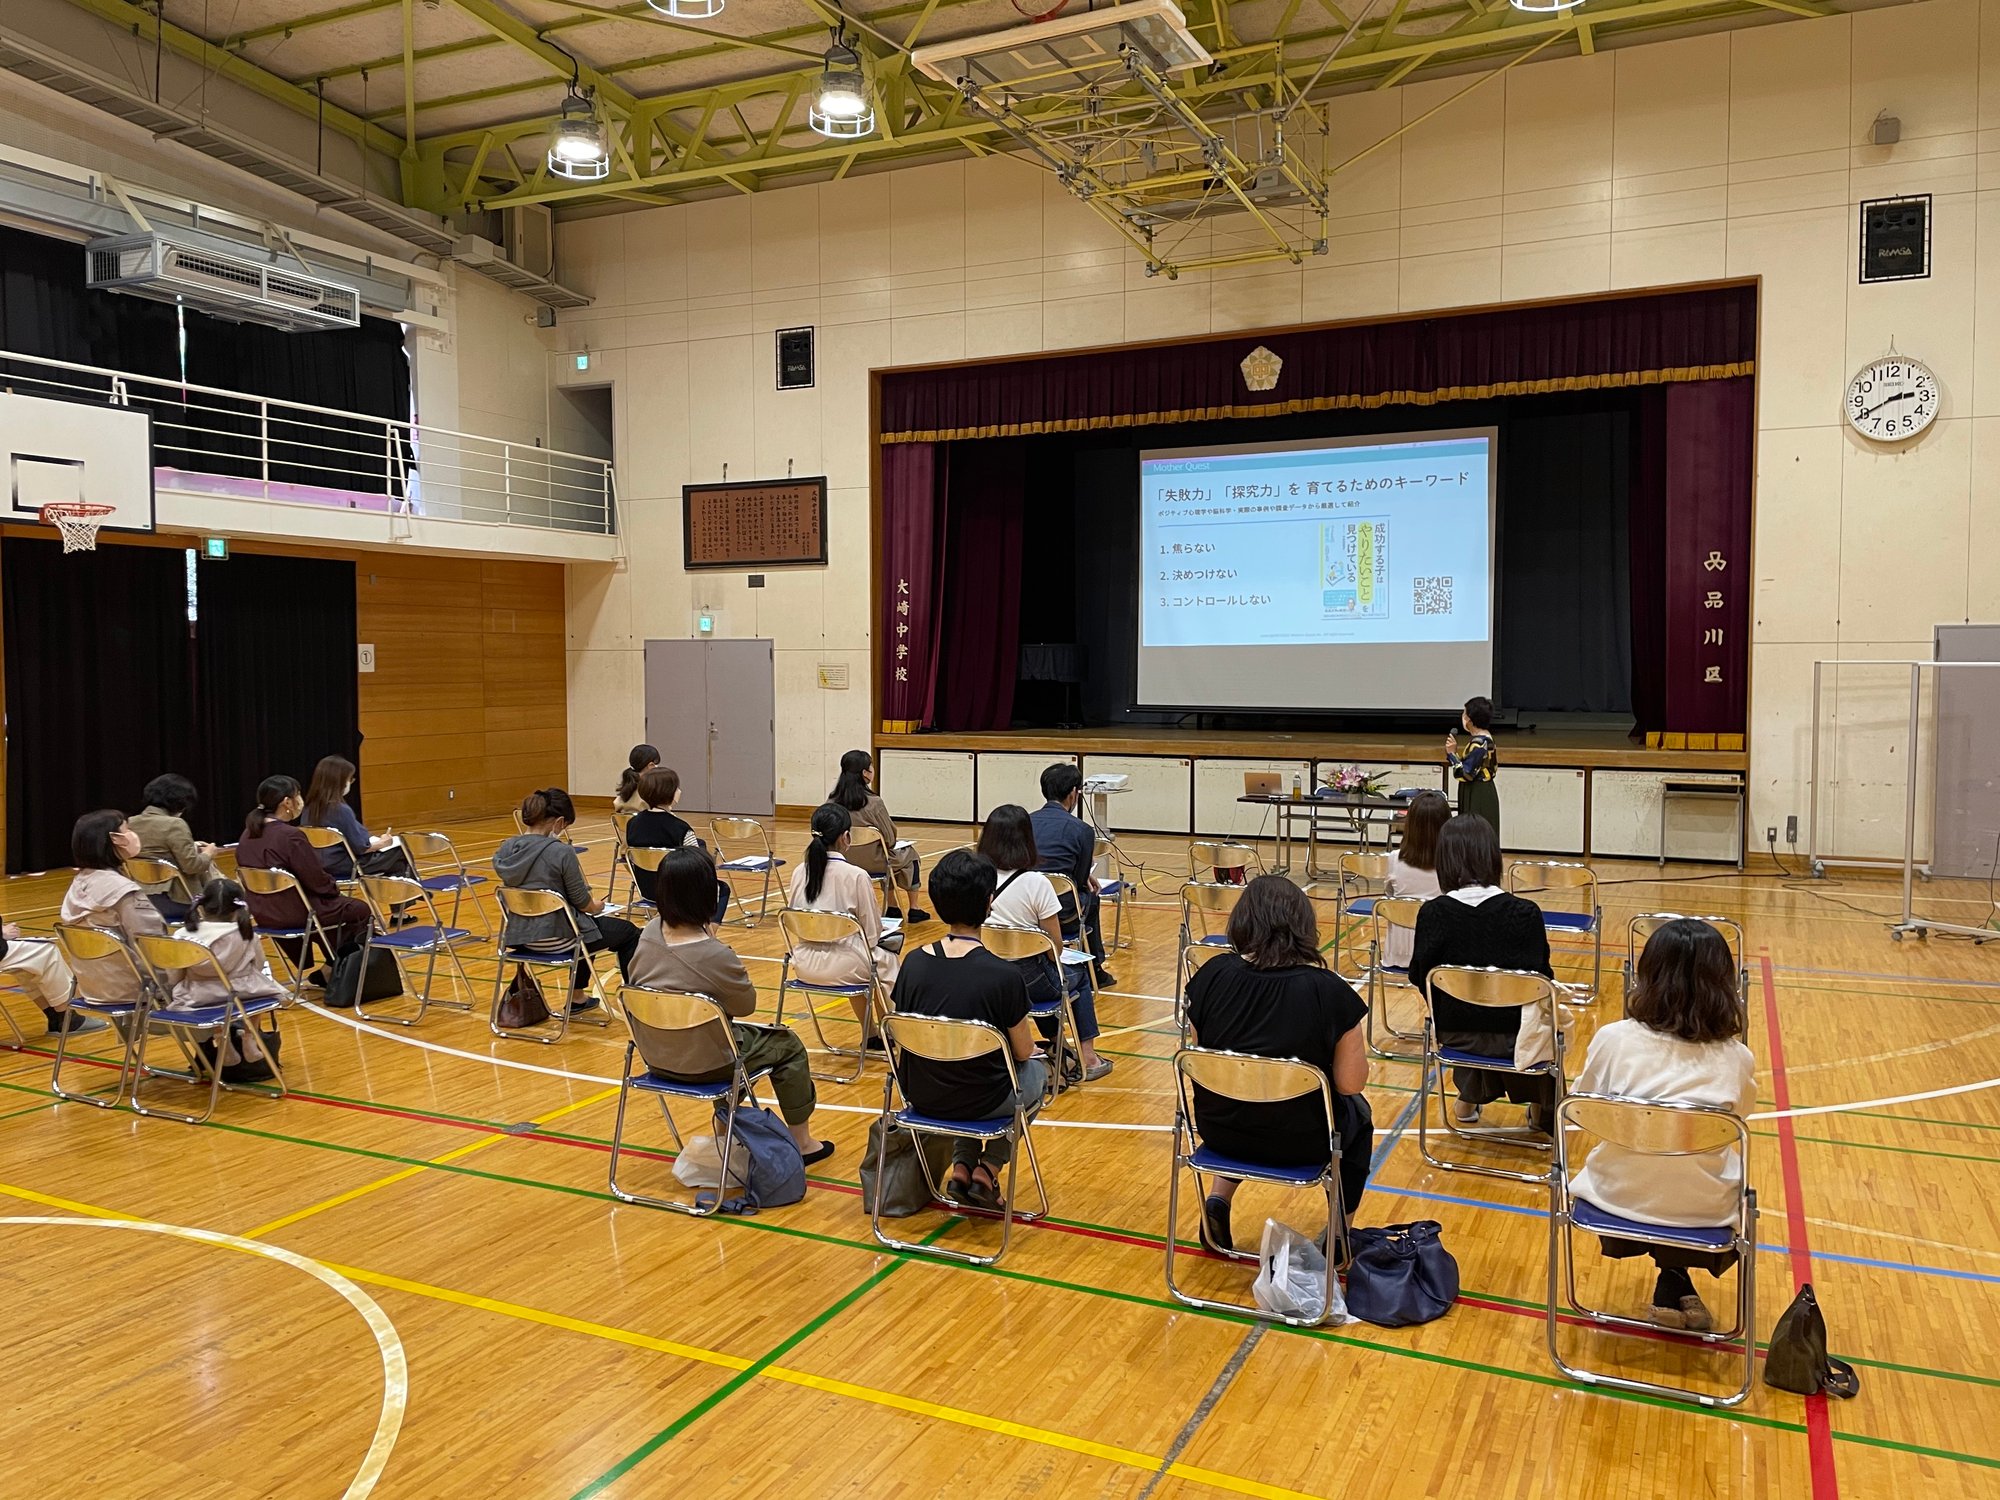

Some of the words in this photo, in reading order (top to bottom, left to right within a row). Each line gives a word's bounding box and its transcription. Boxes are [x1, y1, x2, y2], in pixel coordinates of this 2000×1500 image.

[1873, 370, 1882, 381] 11
[1887, 366, 1900, 377] 12
[1859, 381, 1872, 393] 10
[1916, 376, 1926, 388] 2
[1854, 395, 1864, 407] 9
[1920, 390, 1930, 402] 3
[1914, 404, 1923, 415] 4
[1872, 418, 1881, 429] 7
[1886, 420, 1896, 432] 6
[1903, 415, 1912, 427] 5
[1153, 463, 1183, 472] Mother
[1186, 462, 1210, 472] Quest
[1307, 472, 1469, 495] 育てるためのキーワード
[1172, 543, 1216, 554] 焦らない
[1346, 524, 1357, 583] 見つけている
[1374, 523, 1386, 583] 成功する子は
[1172, 569, 1238, 581] 決めつけない
[1173, 595, 1271, 607] コントロールしない
[895, 579, 910, 681] 大崎中学校
